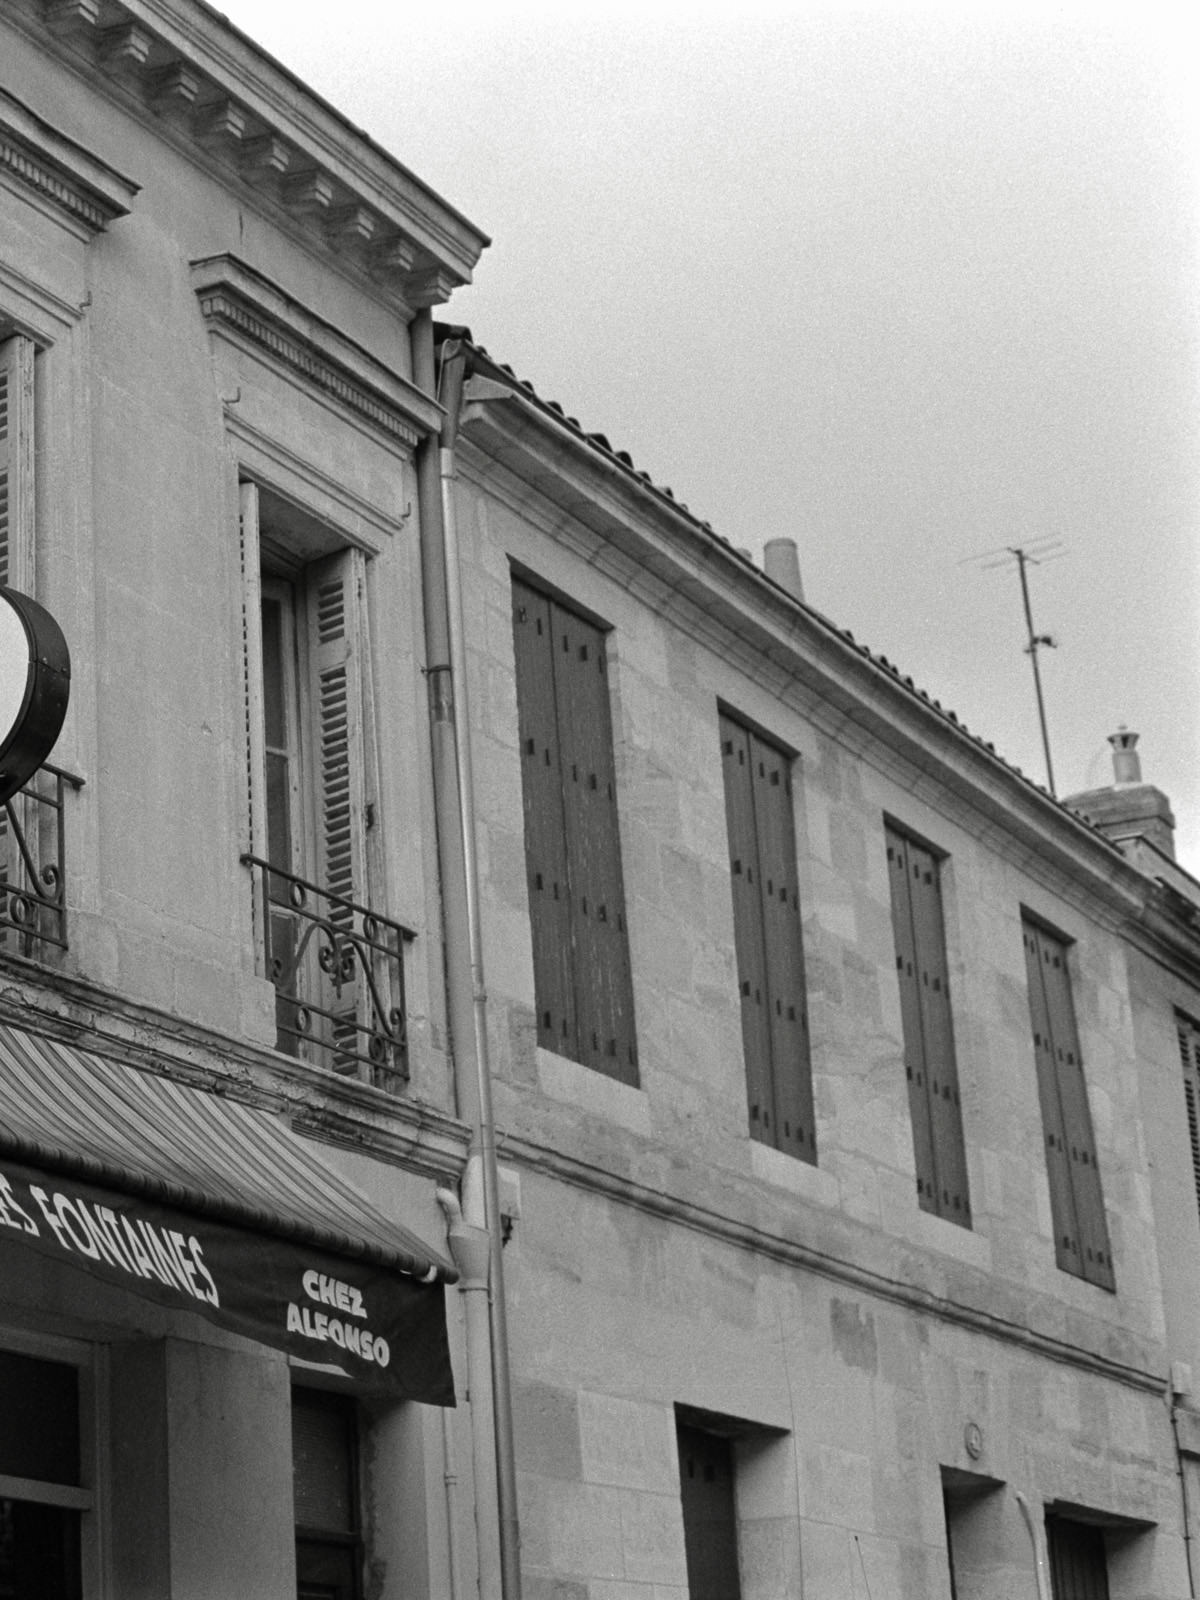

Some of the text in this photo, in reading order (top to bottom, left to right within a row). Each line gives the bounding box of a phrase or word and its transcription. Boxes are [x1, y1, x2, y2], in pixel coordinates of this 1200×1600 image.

[29, 1183, 220, 1309] FONTAINES
[302, 1269, 368, 1319] CHEZ
[286, 1301, 390, 1368] ALFONSO
